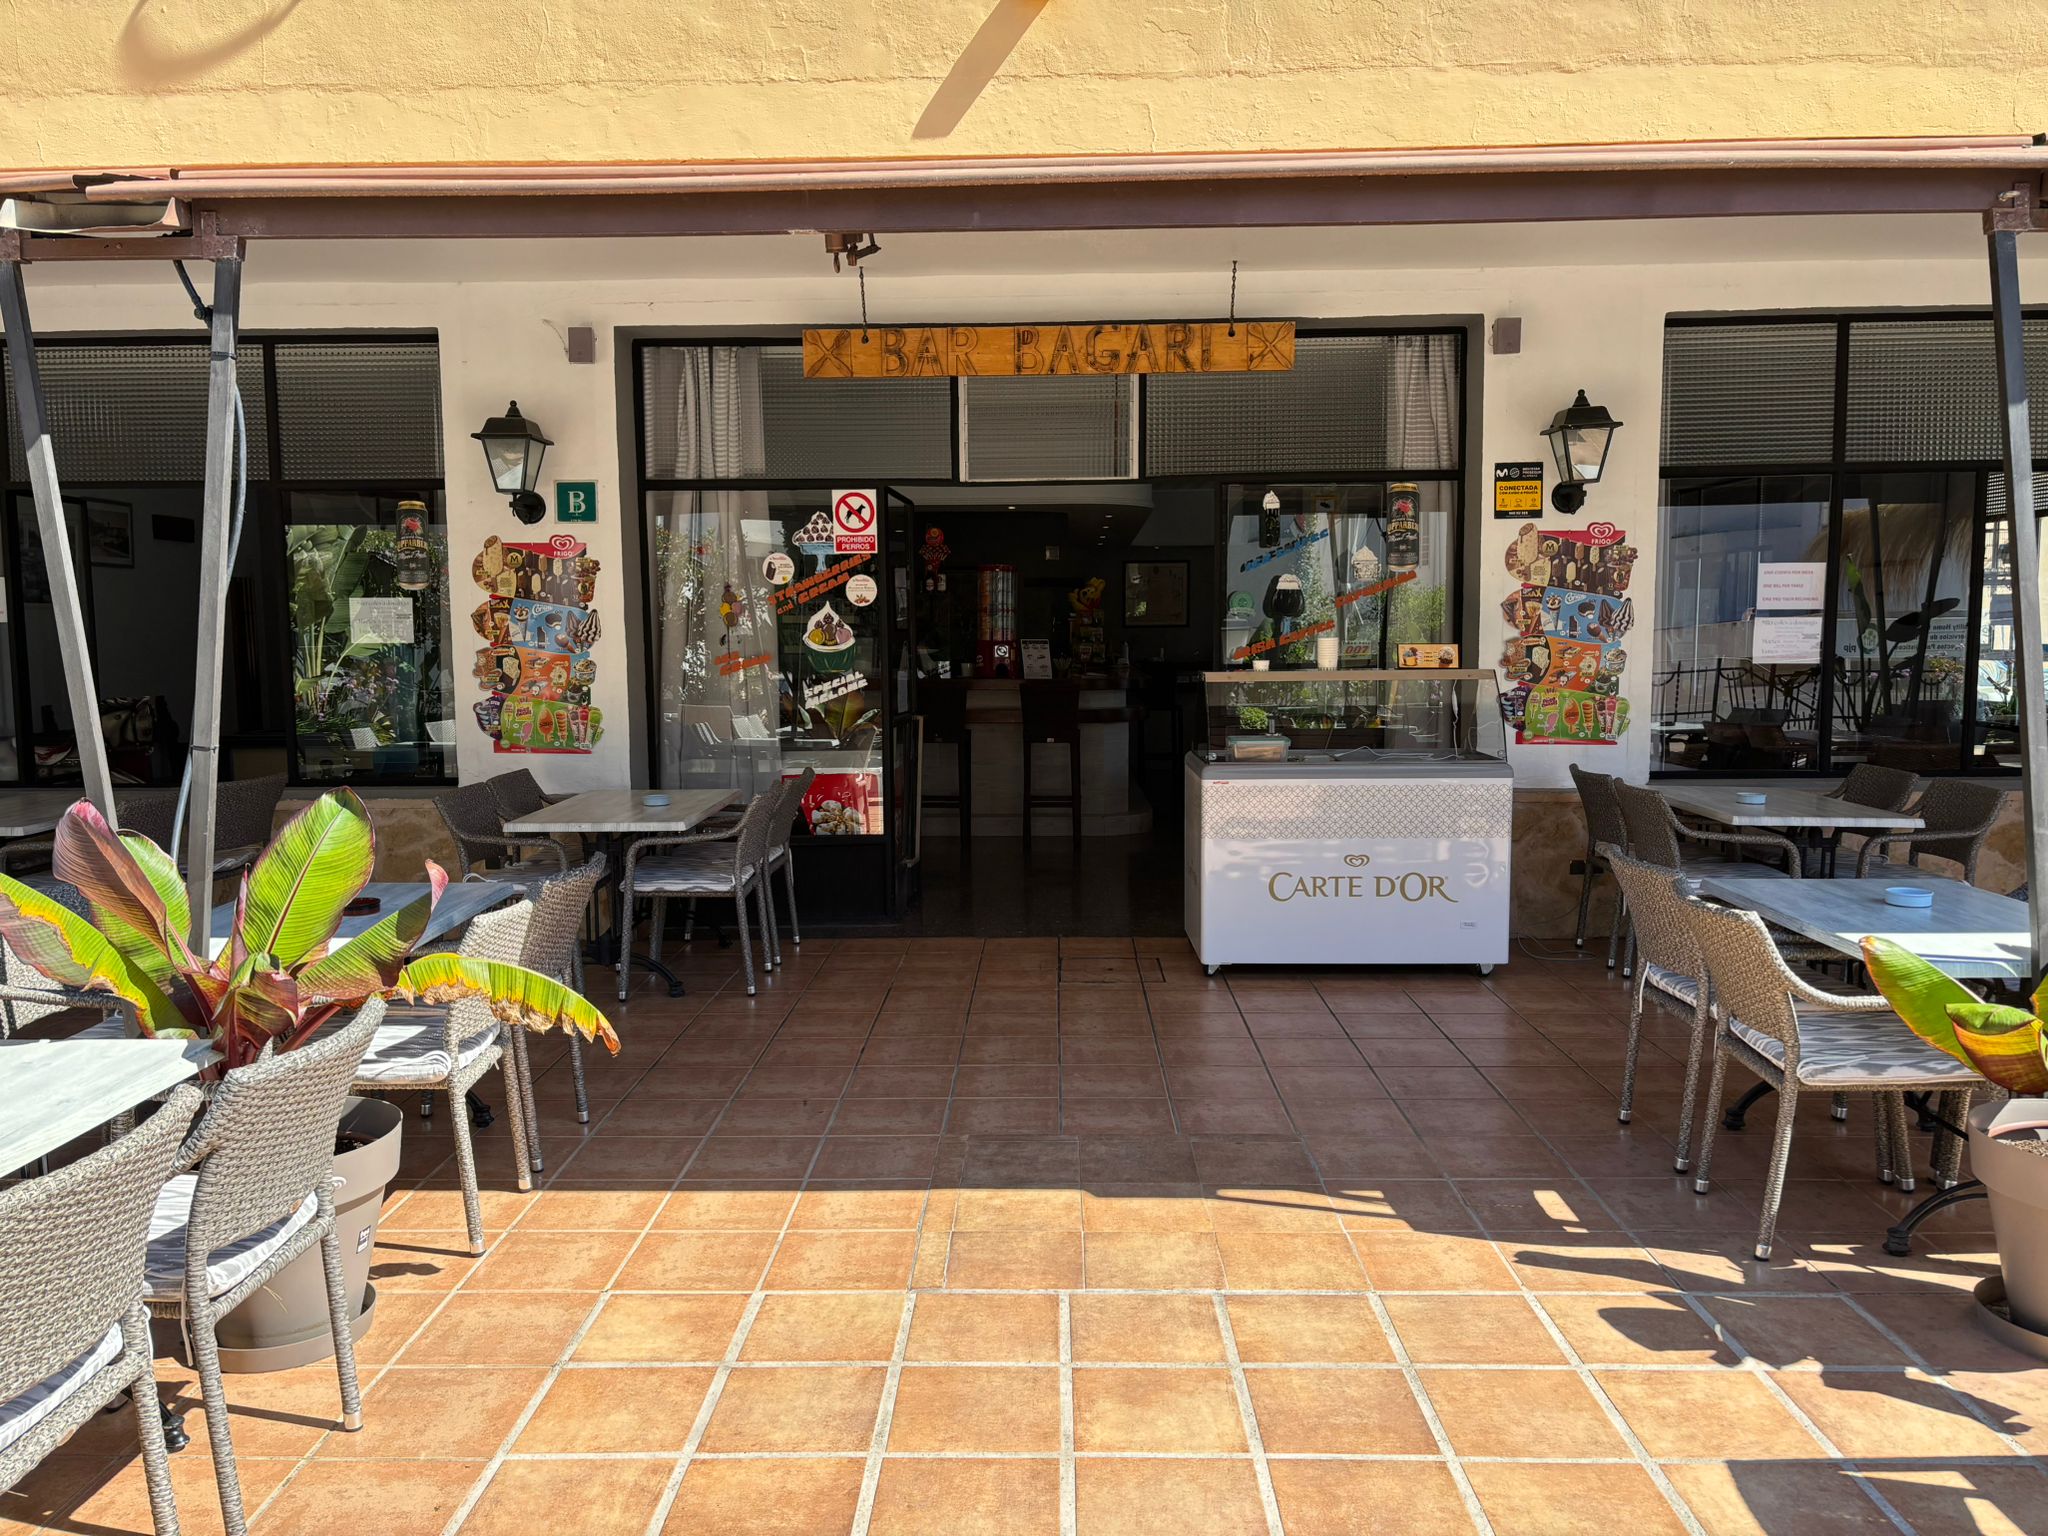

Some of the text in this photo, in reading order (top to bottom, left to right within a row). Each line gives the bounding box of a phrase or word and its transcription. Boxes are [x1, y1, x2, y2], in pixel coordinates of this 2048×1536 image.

[881, 323, 1212, 376] BAR BAGARI
[567, 490, 586, 514] B
[768, 553, 872, 605] STRAWBERRIES
[777, 600, 794, 615] and
[798, 572, 850, 605] CREAM
[1345, 646, 1368, 654] 007
[805, 670, 864, 698] SPECIAL
[1268, 872, 1459, 904] CARTE D'OR
